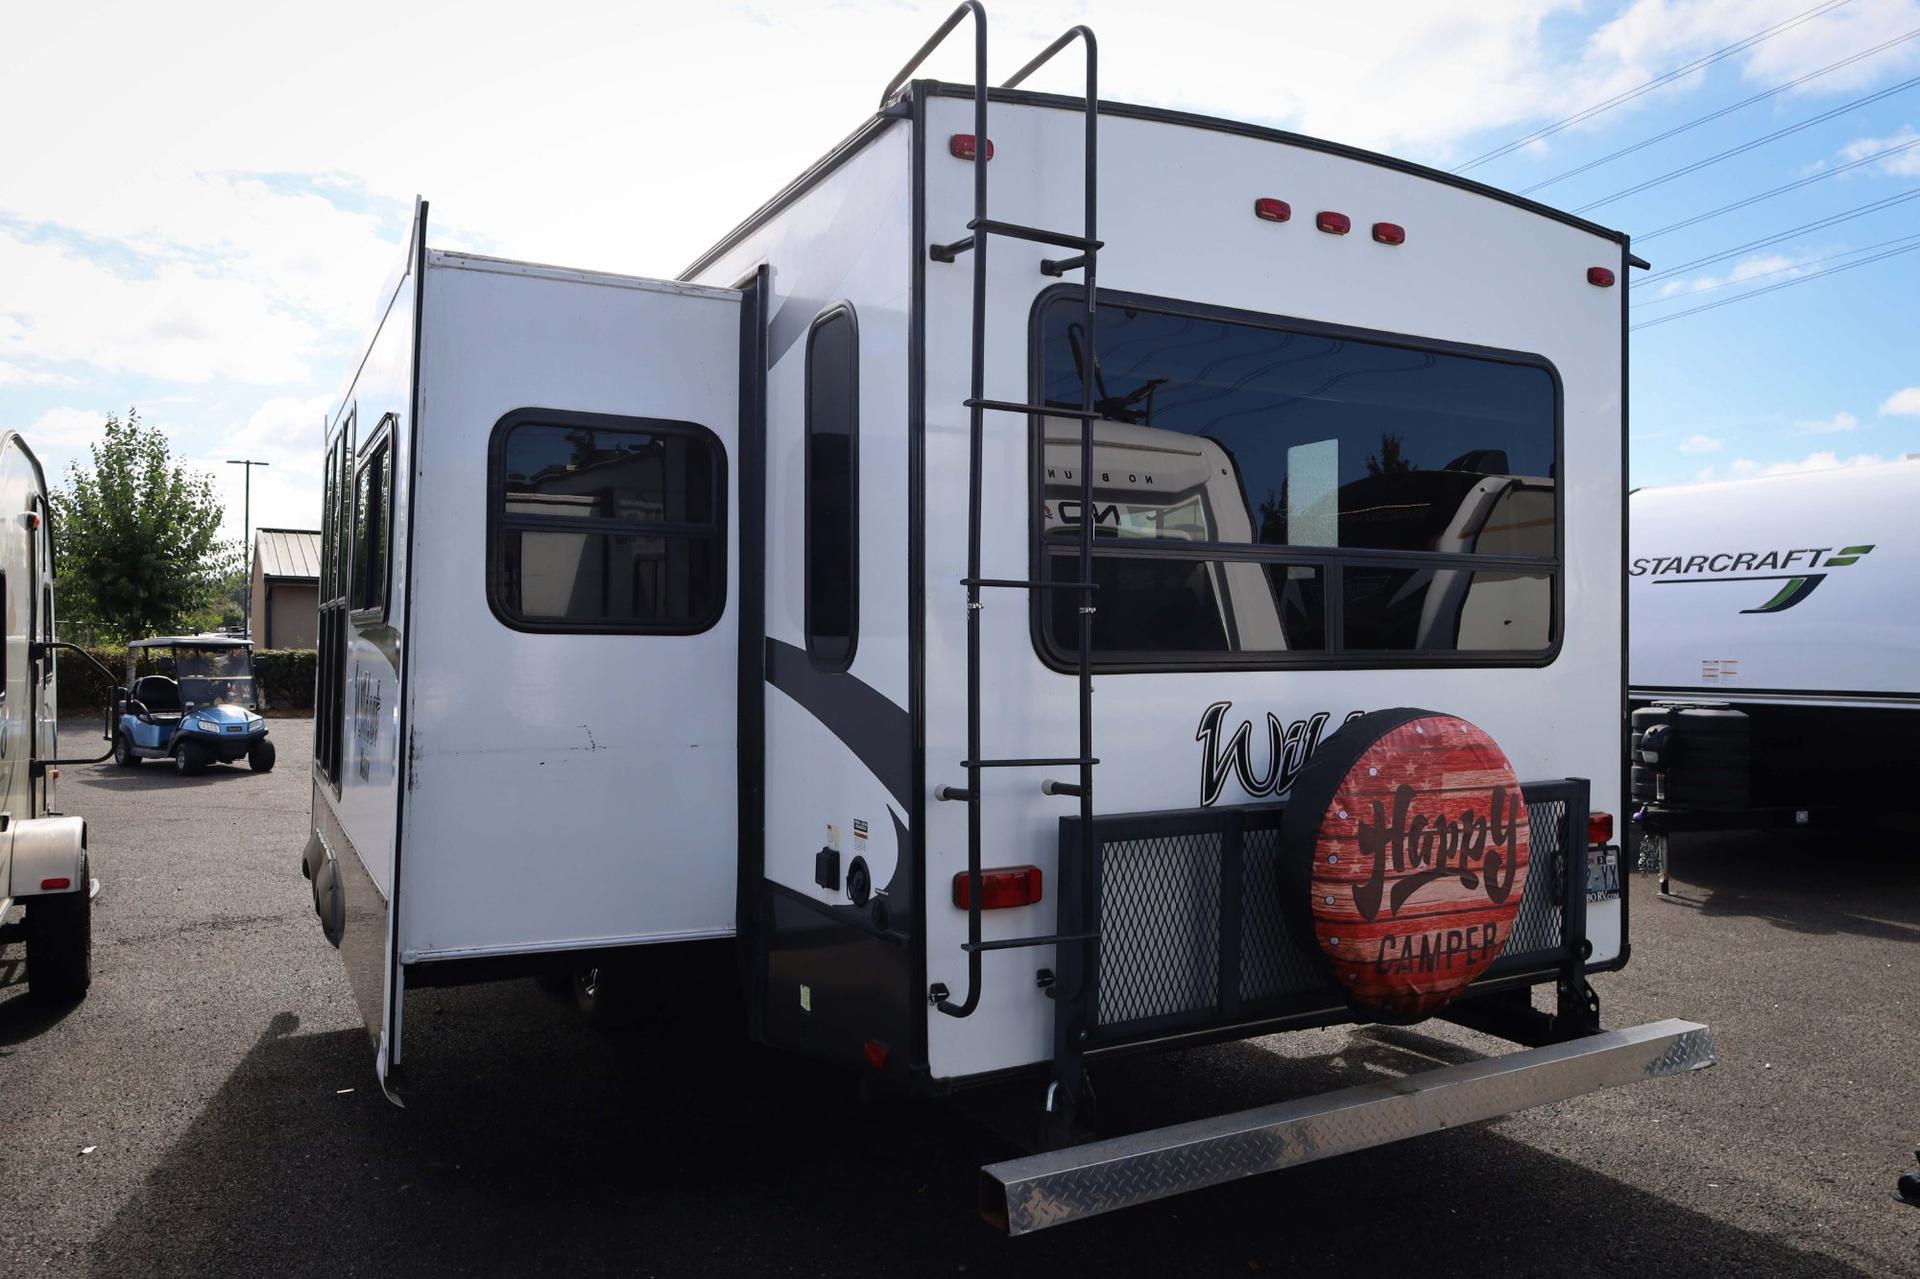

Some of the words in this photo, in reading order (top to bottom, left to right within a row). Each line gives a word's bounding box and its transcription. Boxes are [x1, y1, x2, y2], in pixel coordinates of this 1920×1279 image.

[1629, 547, 1832, 576] STARCRAFT
[1352, 784, 1518, 921] Happy
[1374, 922, 1498, 976] CAMPER
